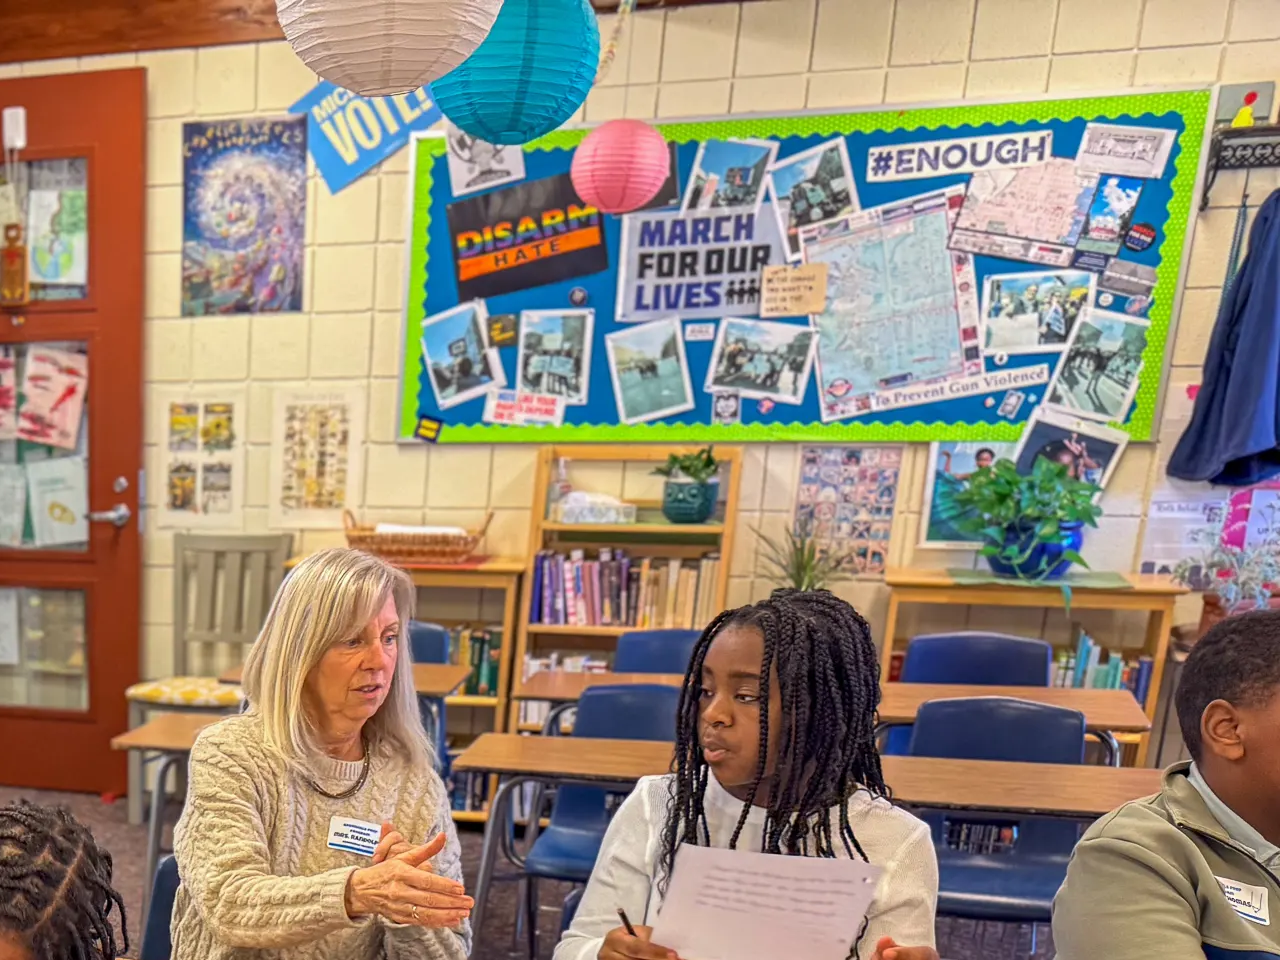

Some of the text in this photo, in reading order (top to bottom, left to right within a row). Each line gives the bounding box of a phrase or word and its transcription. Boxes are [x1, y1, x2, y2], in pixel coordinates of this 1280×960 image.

[871, 135, 1047, 177] #ENOUGH
[455, 203, 599, 259] DISARM
[638, 213, 755, 247] MARCH
[494, 240, 562, 268] HATE
[637, 245, 772, 279] FOR OUR
[634, 281, 723, 311] LIVES
[894, 385, 945, 404] Prevent
[949, 379, 980, 395] Gun
[983, 367, 1045, 388] Violence
[351, 834, 379, 845] RANDOLP
